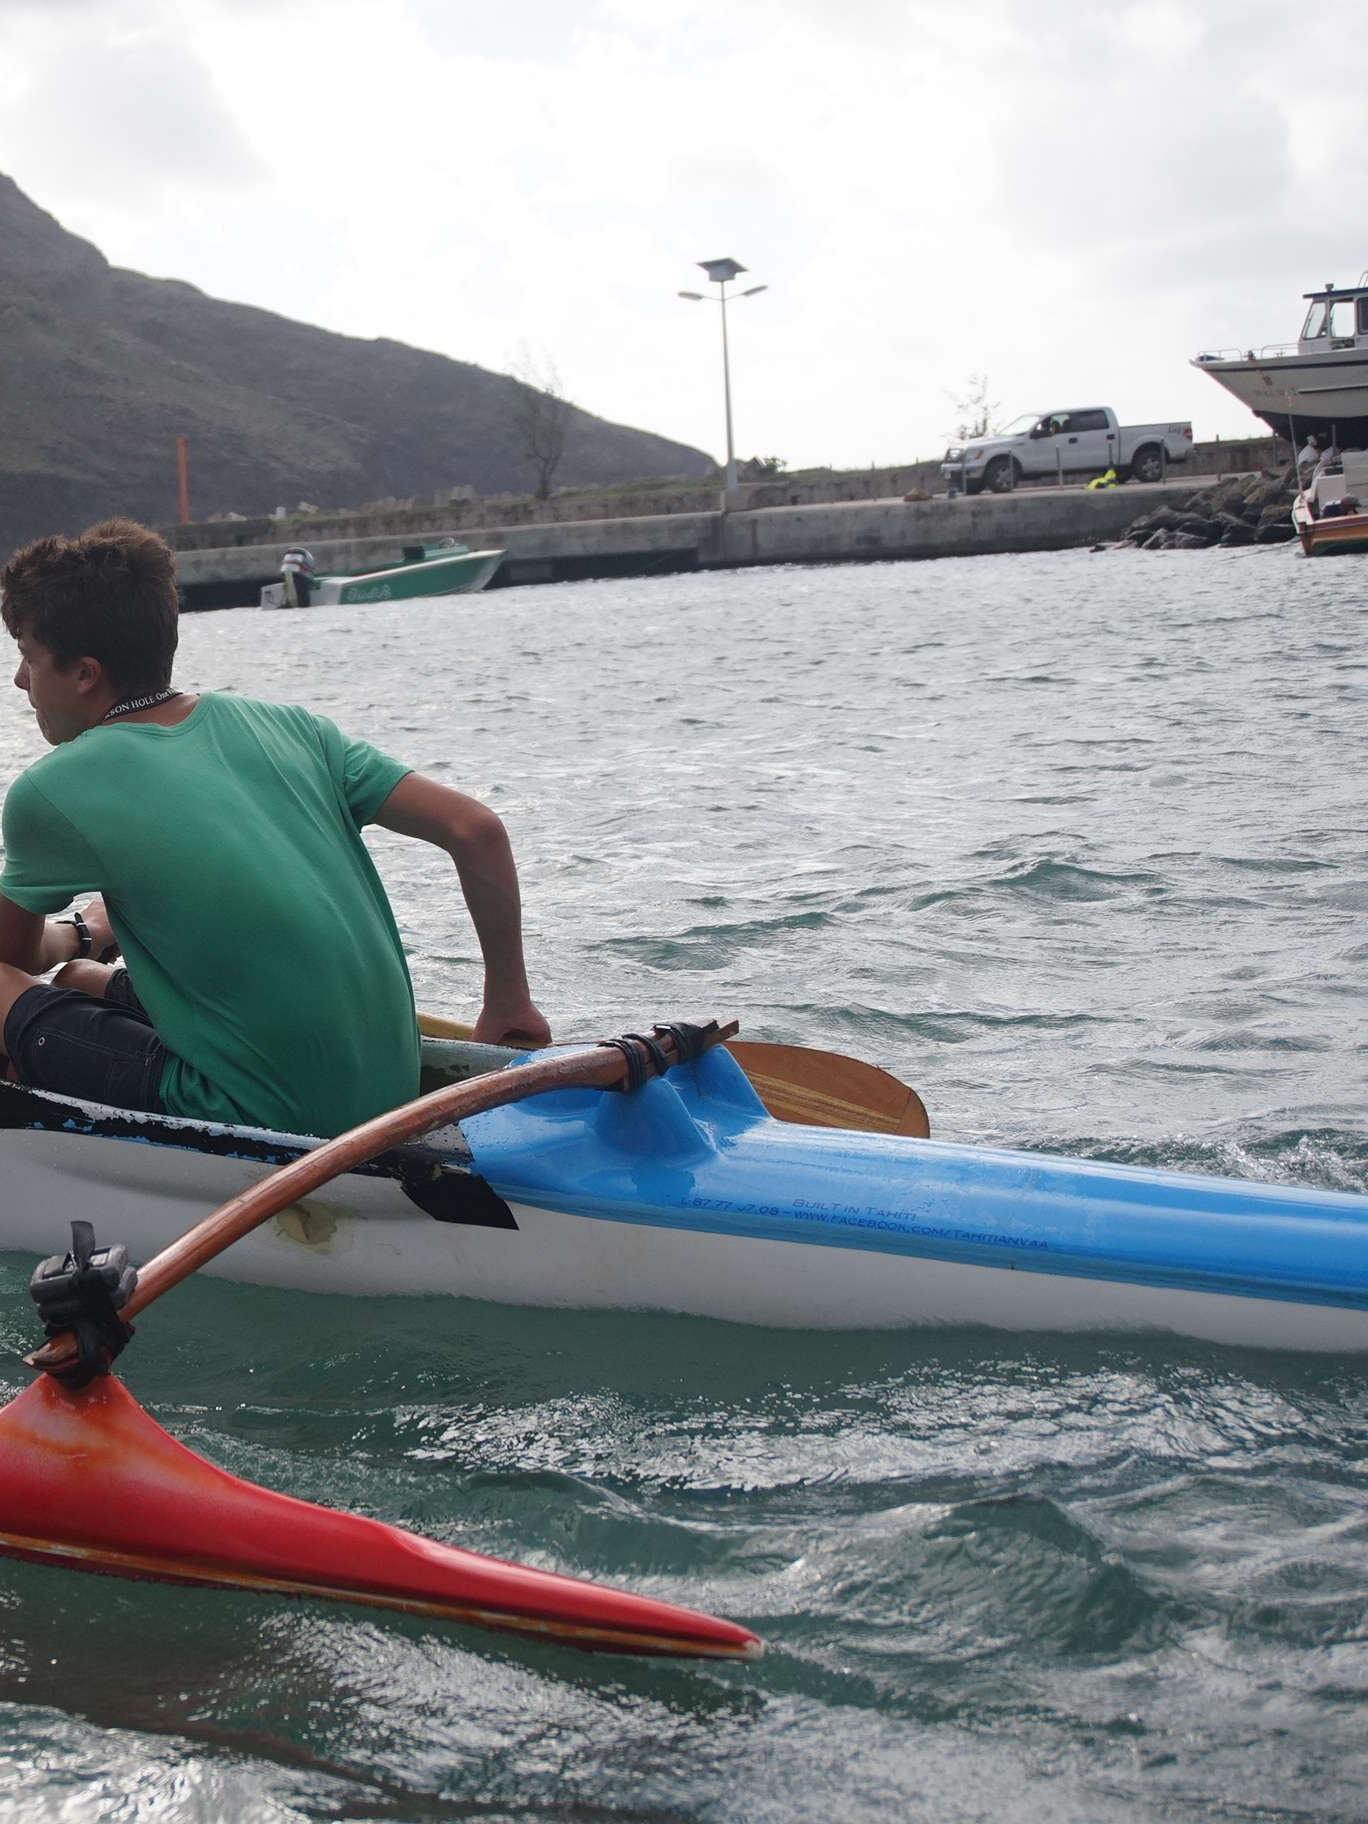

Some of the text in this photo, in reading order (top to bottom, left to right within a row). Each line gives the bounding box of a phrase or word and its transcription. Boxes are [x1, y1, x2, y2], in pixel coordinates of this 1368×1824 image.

[131, 697, 155, 709] HOLE
[792, 1198, 842, 1211] BUILT
[865, 1206, 917, 1221] TAHITI
